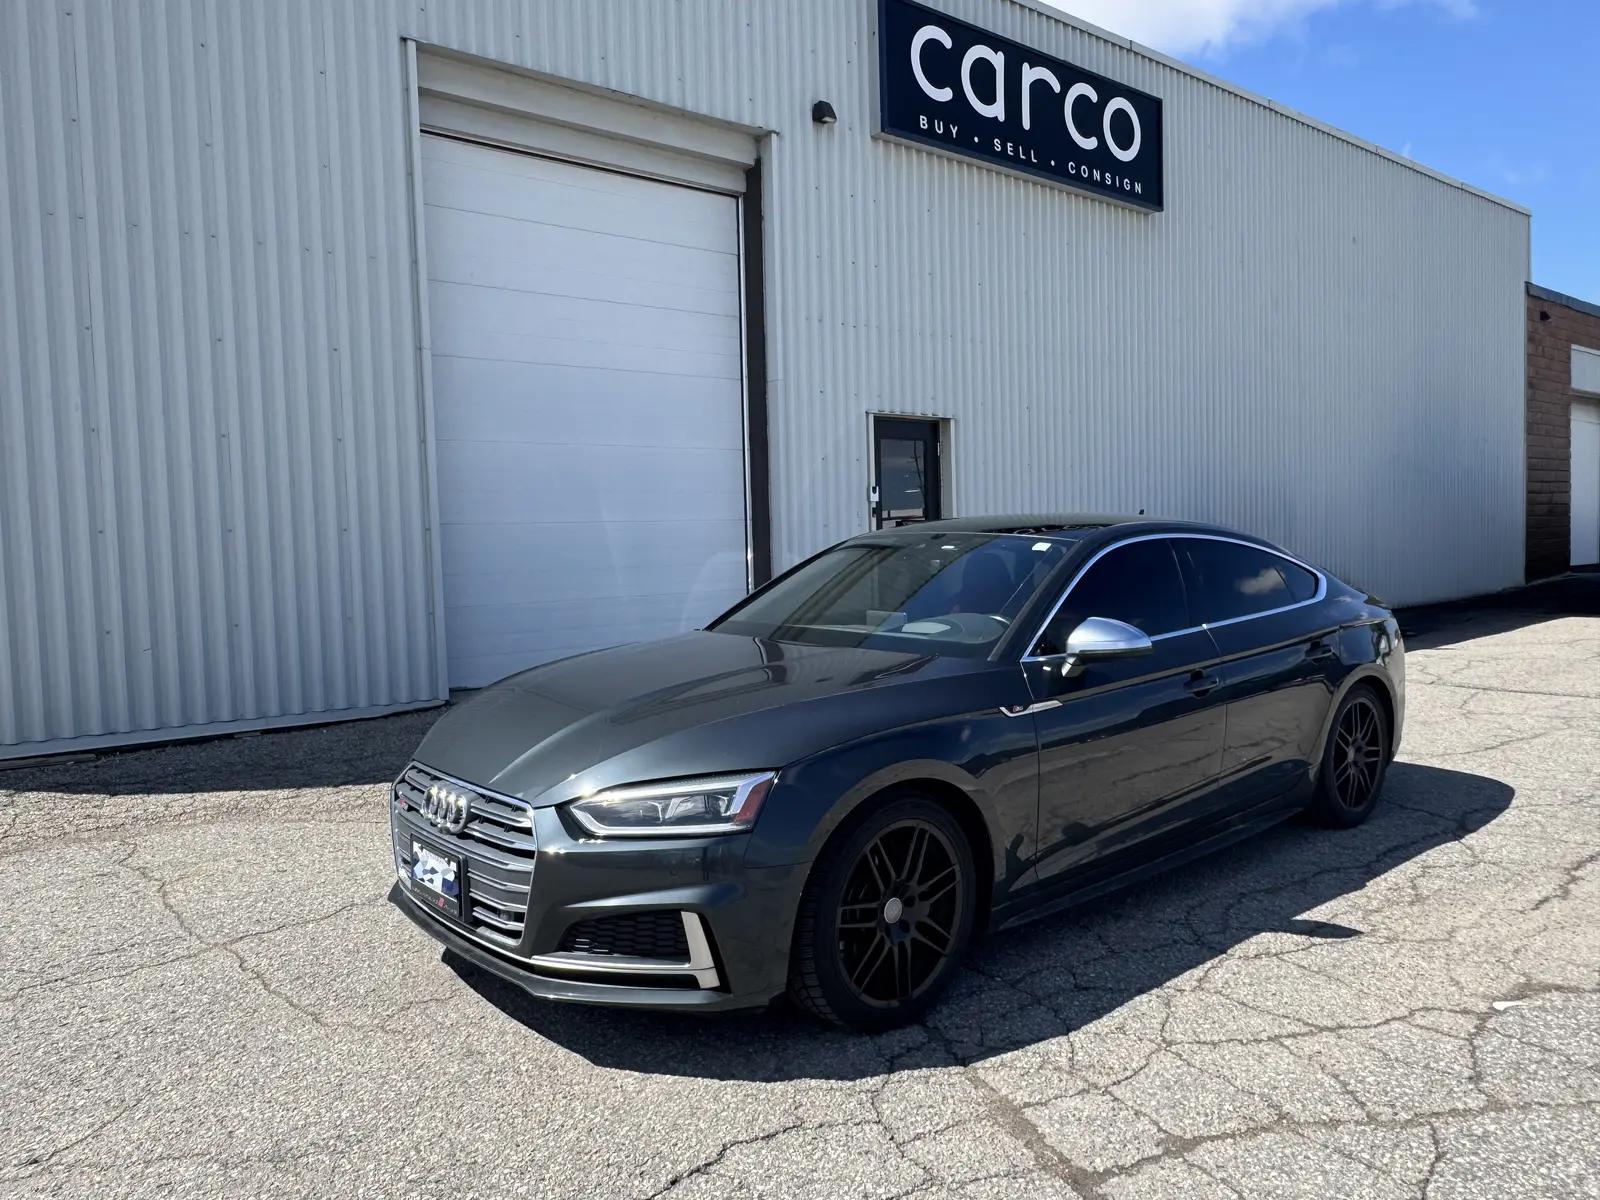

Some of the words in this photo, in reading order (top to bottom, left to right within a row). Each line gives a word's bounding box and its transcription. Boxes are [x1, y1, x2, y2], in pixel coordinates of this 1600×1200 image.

[910, 25, 1142, 162] carco
[919, 115, 958, 138] BUY
[994, 138, 1038, 163] SELL
[1068, 161, 1142, 194] CONSIGN
